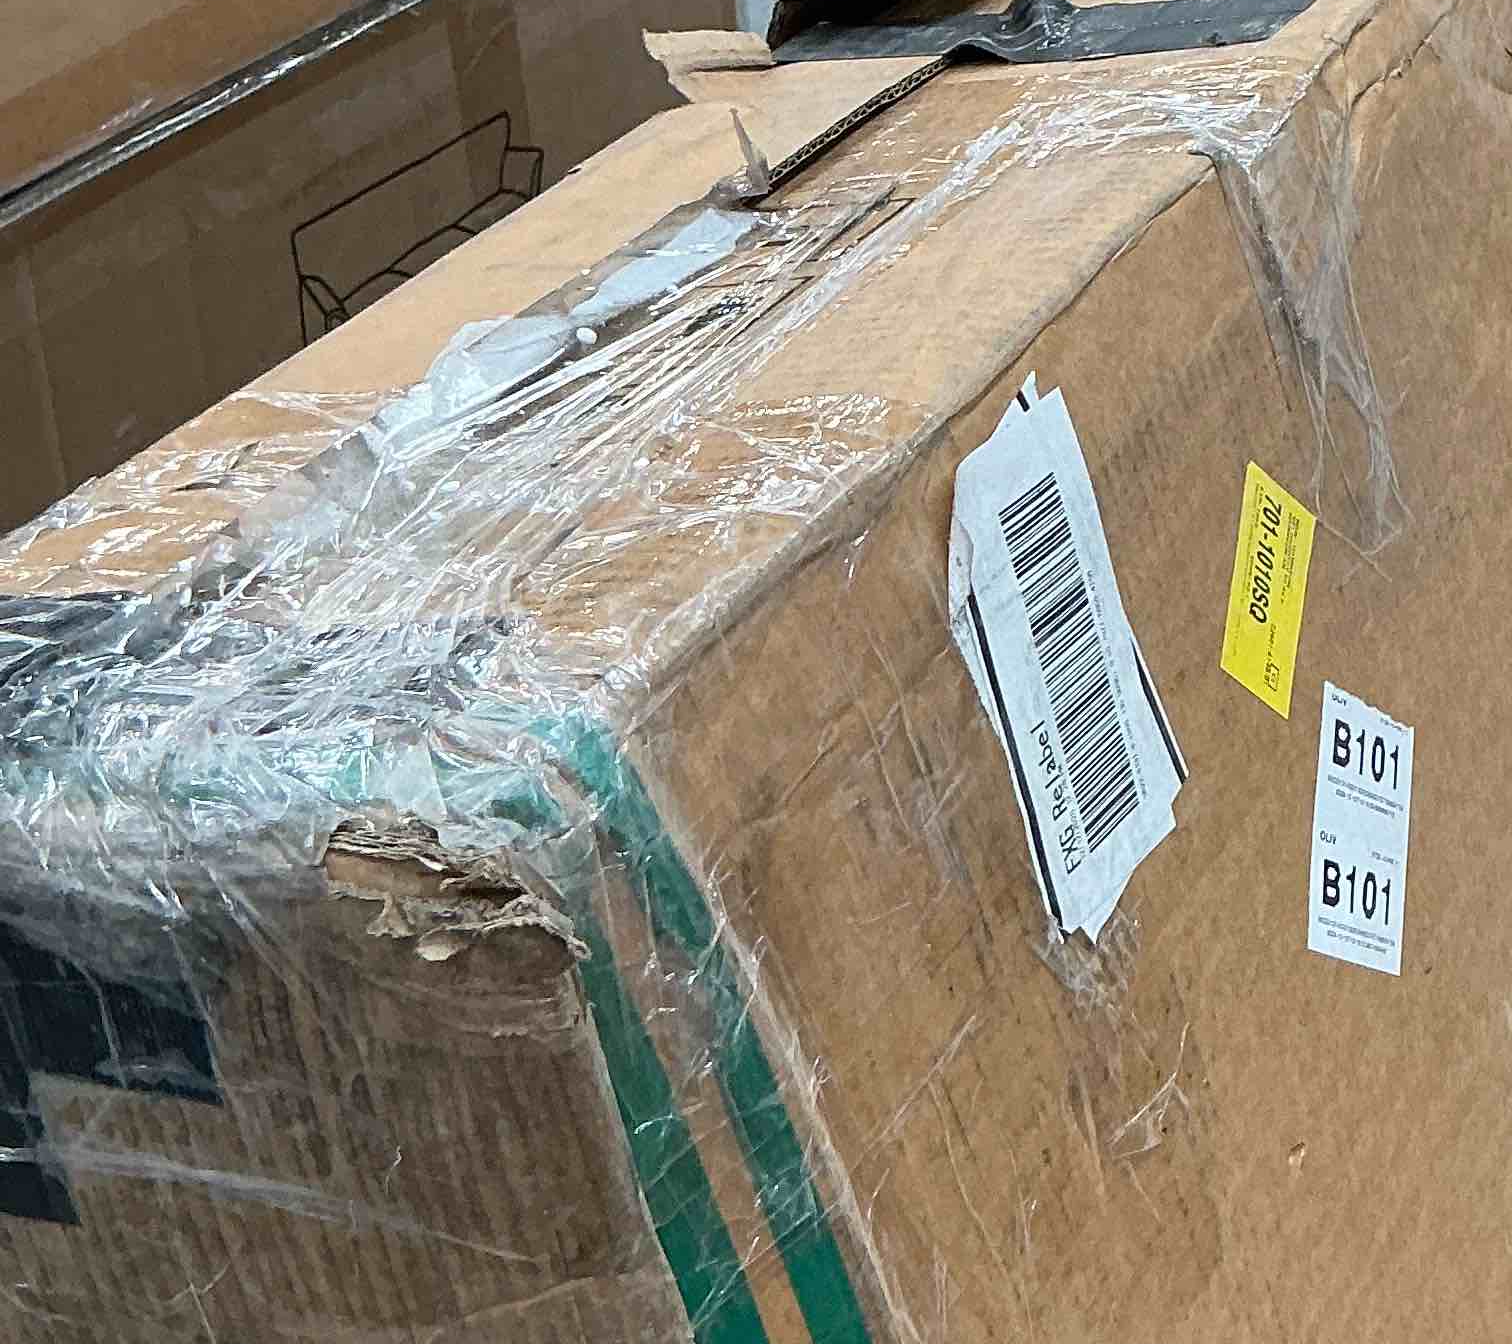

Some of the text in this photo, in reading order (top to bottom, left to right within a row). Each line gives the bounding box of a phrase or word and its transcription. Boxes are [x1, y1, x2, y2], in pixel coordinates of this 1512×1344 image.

[1249, 492, 1283, 625] 701-1010SQ
[1332, 718, 1401, 791] B101
[1058, 824, 1082, 875] FXG
[1322, 858, 1395, 926] B101
